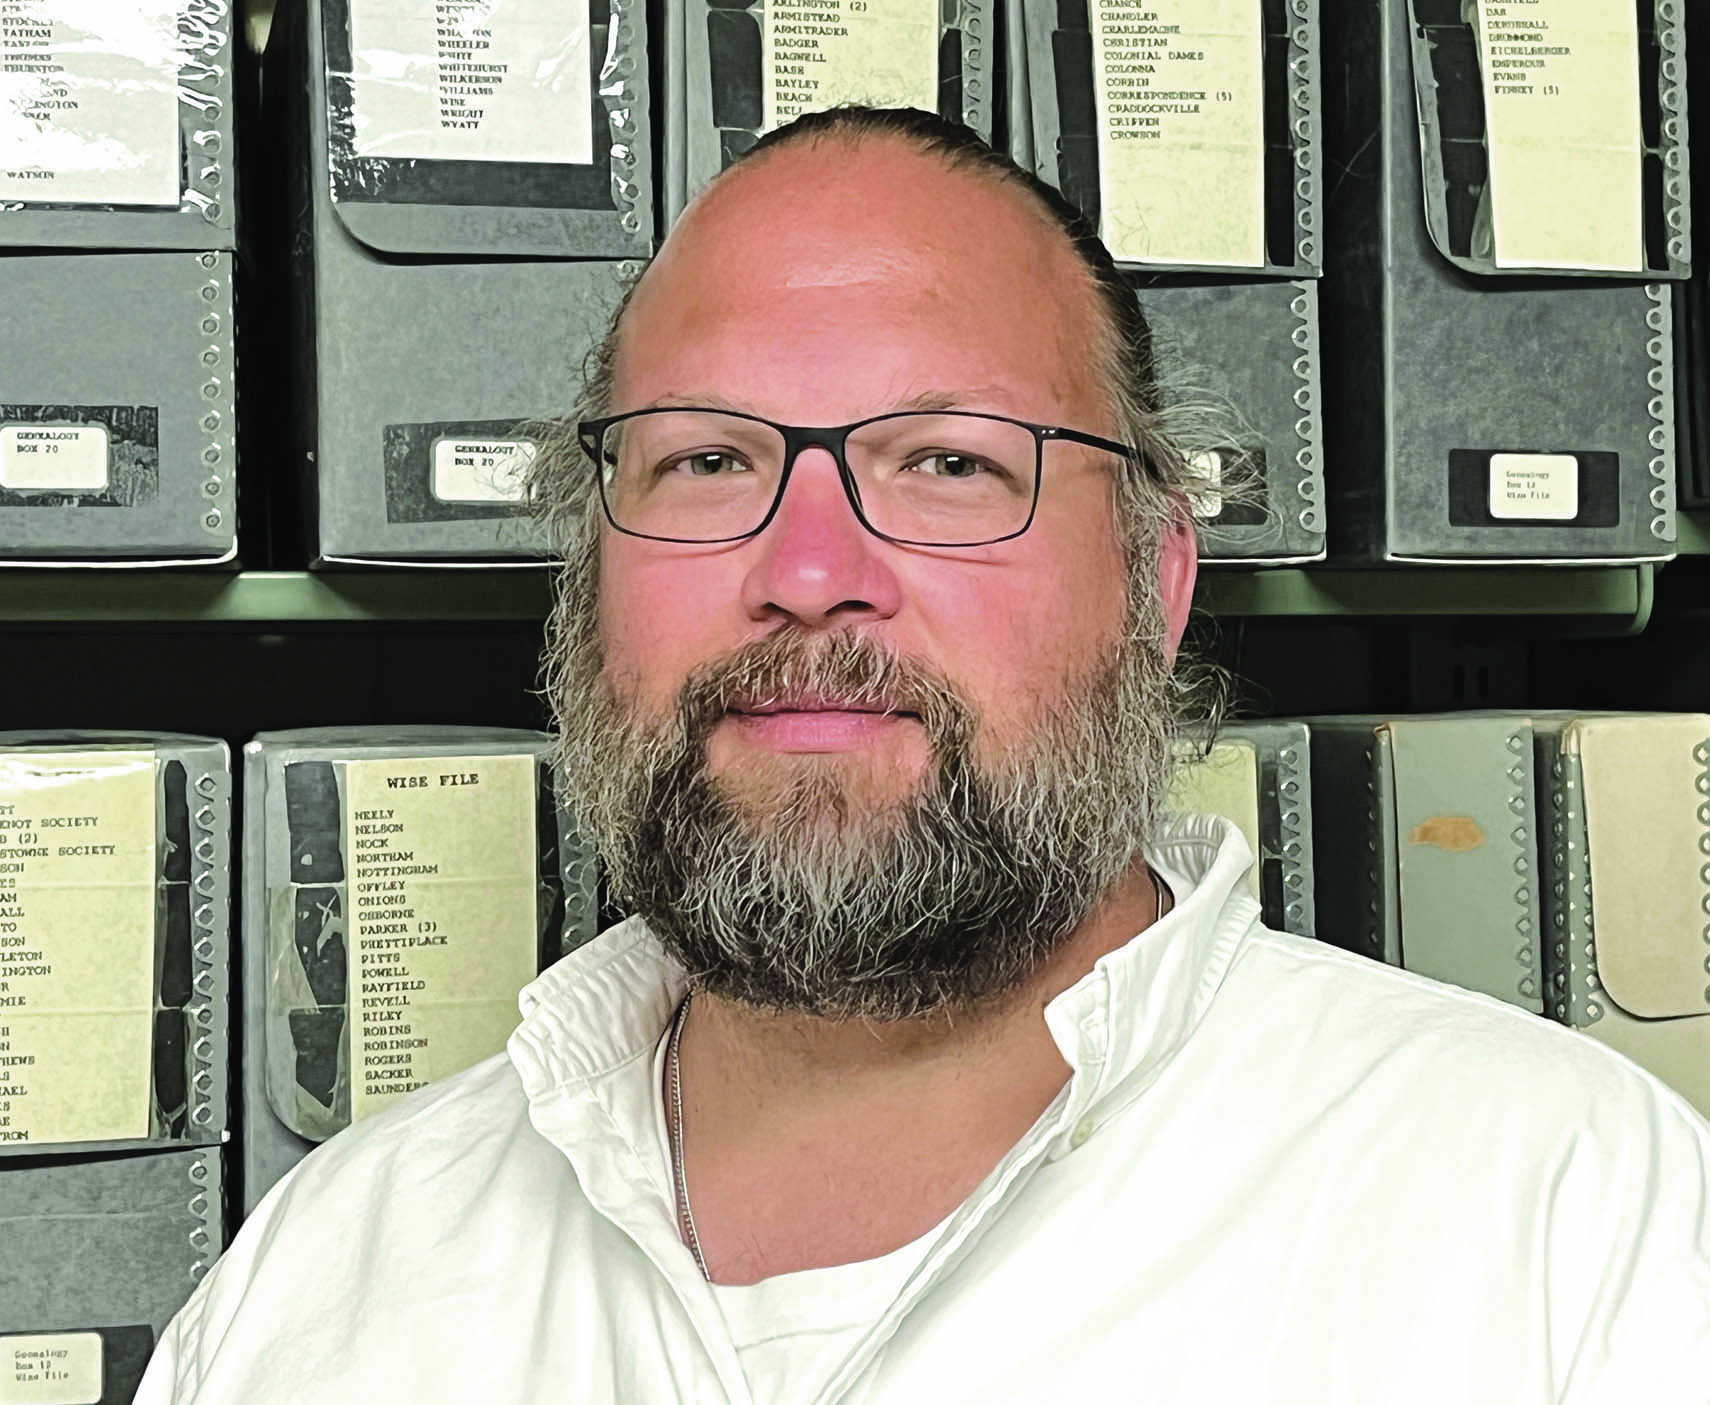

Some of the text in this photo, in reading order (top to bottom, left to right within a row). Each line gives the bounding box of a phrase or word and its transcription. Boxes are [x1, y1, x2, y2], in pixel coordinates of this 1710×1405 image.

[850, 2, 867, 11] (2)
[773, 11, 840, 23] ARMISTEAD
[1101, 12, 1158, 21] CHANDLER
[438, 40, 489, 48] WHEELER
[774, 39, 819, 48] BADGER
[1103, 38, 1167, 47] CHRISTIAN
[1104, 51, 1203, 60] COLONIAL DAMES
[1105, 65, 1155, 73] COLONNA
[776, 79, 819, 89] BAYLEY
[776, 92, 812, 102] BEACH
[1107, 91, 1207, 100] CORRESPONDENCE
[440, 98, 465, 106] WISE
[441, 121, 479, 129] WYATT
[1109, 117, 1159, 126] CRIPPEN
[7, 171, 54, 179] WATSON
[17, 445, 58, 453] BOX 20
[455, 458, 494, 466] BOX 20
[387, 773, 479, 789] WISE FILE
[355, 809, 394, 820] NEELY
[41, 817, 98, 828] SOCIETY
[355, 823, 404, 835] NELSON
[19, 833, 38, 844] (2)
[356, 838, 389, 849] NOCK
[58, 845, 116, 856] SOCIETY
[357, 851, 414, 864] NORTHAM
[357, 864, 439, 878] NOTTINGHAM
[357, 881, 405, 892] OFFLEY
[358, 894, 406, 907] ONIONS
[358, 908, 415, 921] OSBORNE
[1, 922, 17, 932] TO
[360, 923, 408, 935] PARKER
[1, 937, 25, 947] SON
[361, 952, 400, 964] PITTS
[362, 967, 410, 979] POWELL
[362, 980, 426, 993] RAYFIELD
[362, 996, 411, 1008] REVELL
[363, 1011, 403, 1022] RILEY
[363, 1024, 411, 1037] ROBINS
[364, 1038, 428, 1051] ROBINSON
[364, 1054, 412, 1066] ROGERS
[365, 1068, 413, 1081] SACKER
